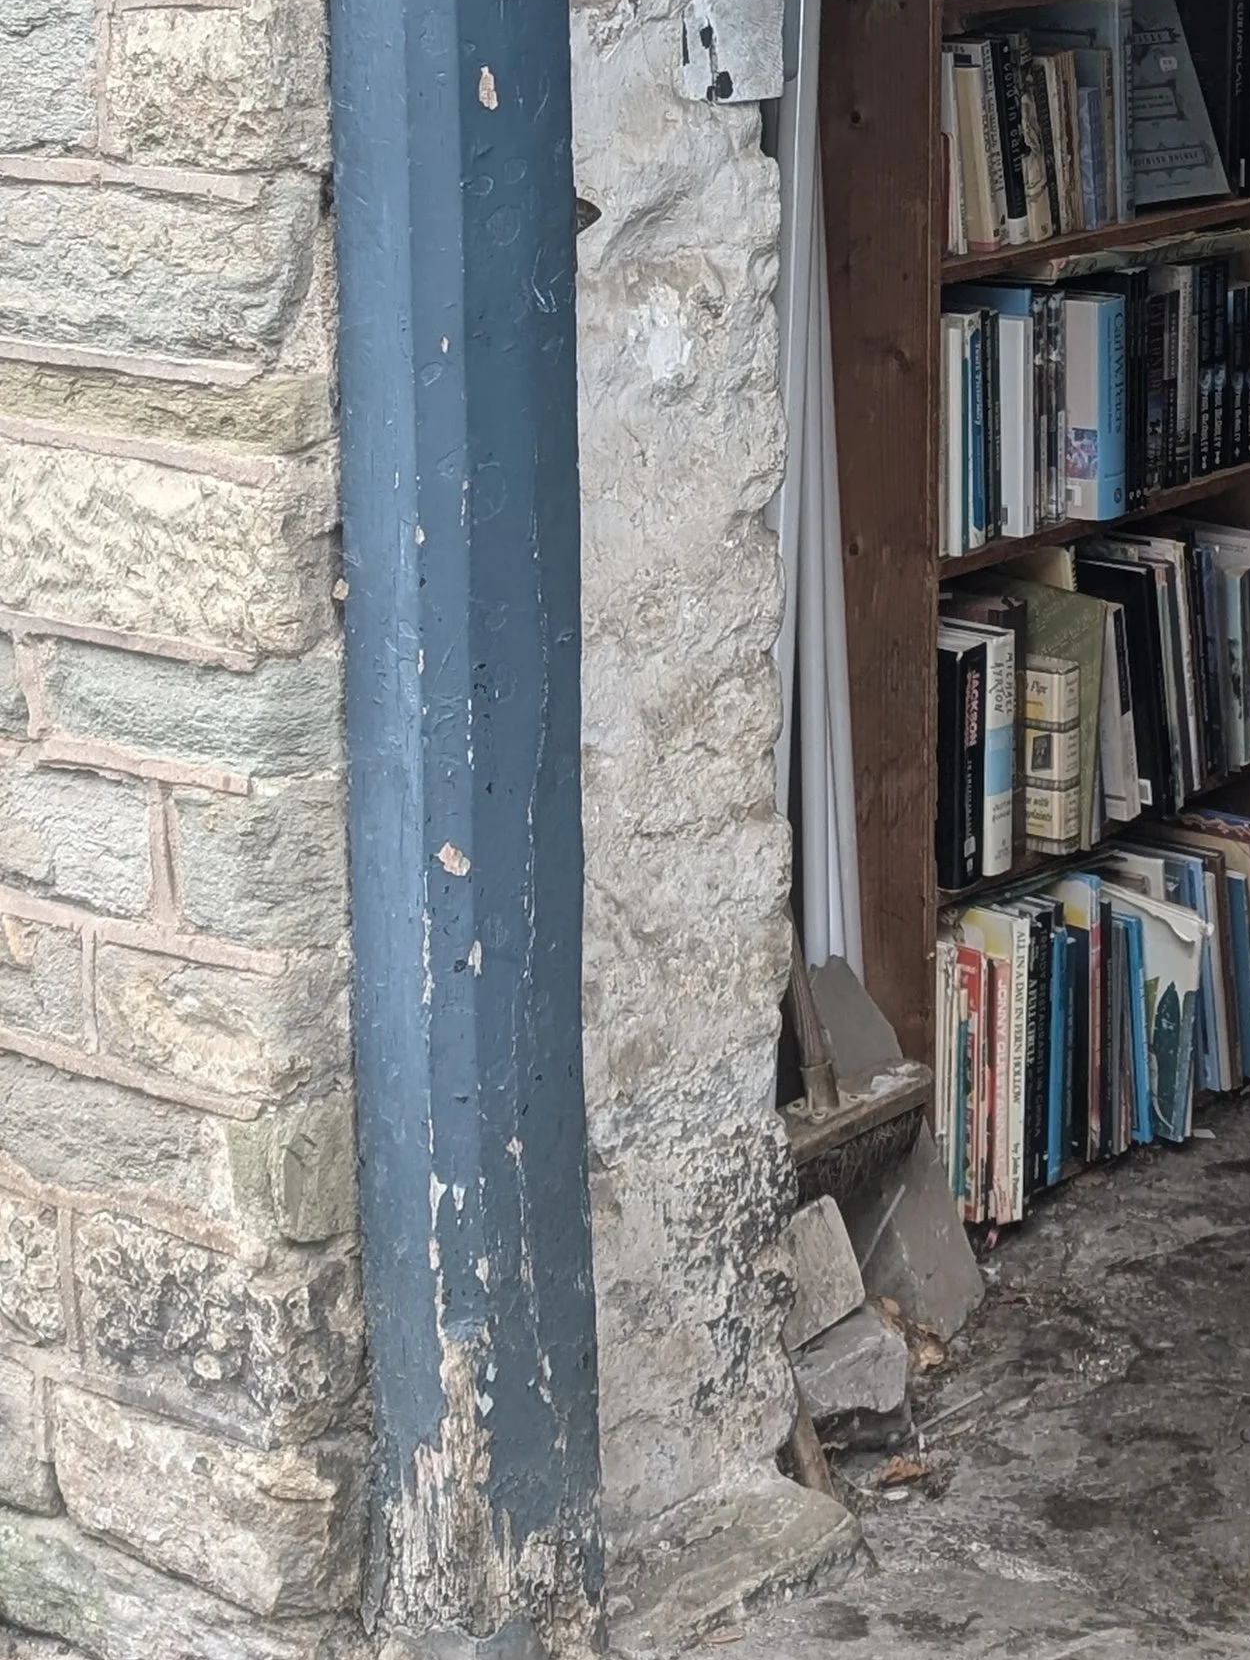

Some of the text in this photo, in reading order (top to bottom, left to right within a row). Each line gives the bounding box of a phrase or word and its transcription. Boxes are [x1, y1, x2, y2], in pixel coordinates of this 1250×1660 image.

[989, 661, 1006, 713] AYRTON
[1004, 652, 1013, 714] MICHAEL
[963, 670, 981, 746] JACKSON
[1017, 931, 1025, 953] ALL
[1015, 982, 1024, 1002] DAY
[1015, 1023, 1023, 1052] FERN
[995, 979, 1007, 1167] JONNY QUEST ANNUAL
[1013, 1056, 1022, 1104] HOLLOW
[1034, 1094, 1042, 1137] CHINA
